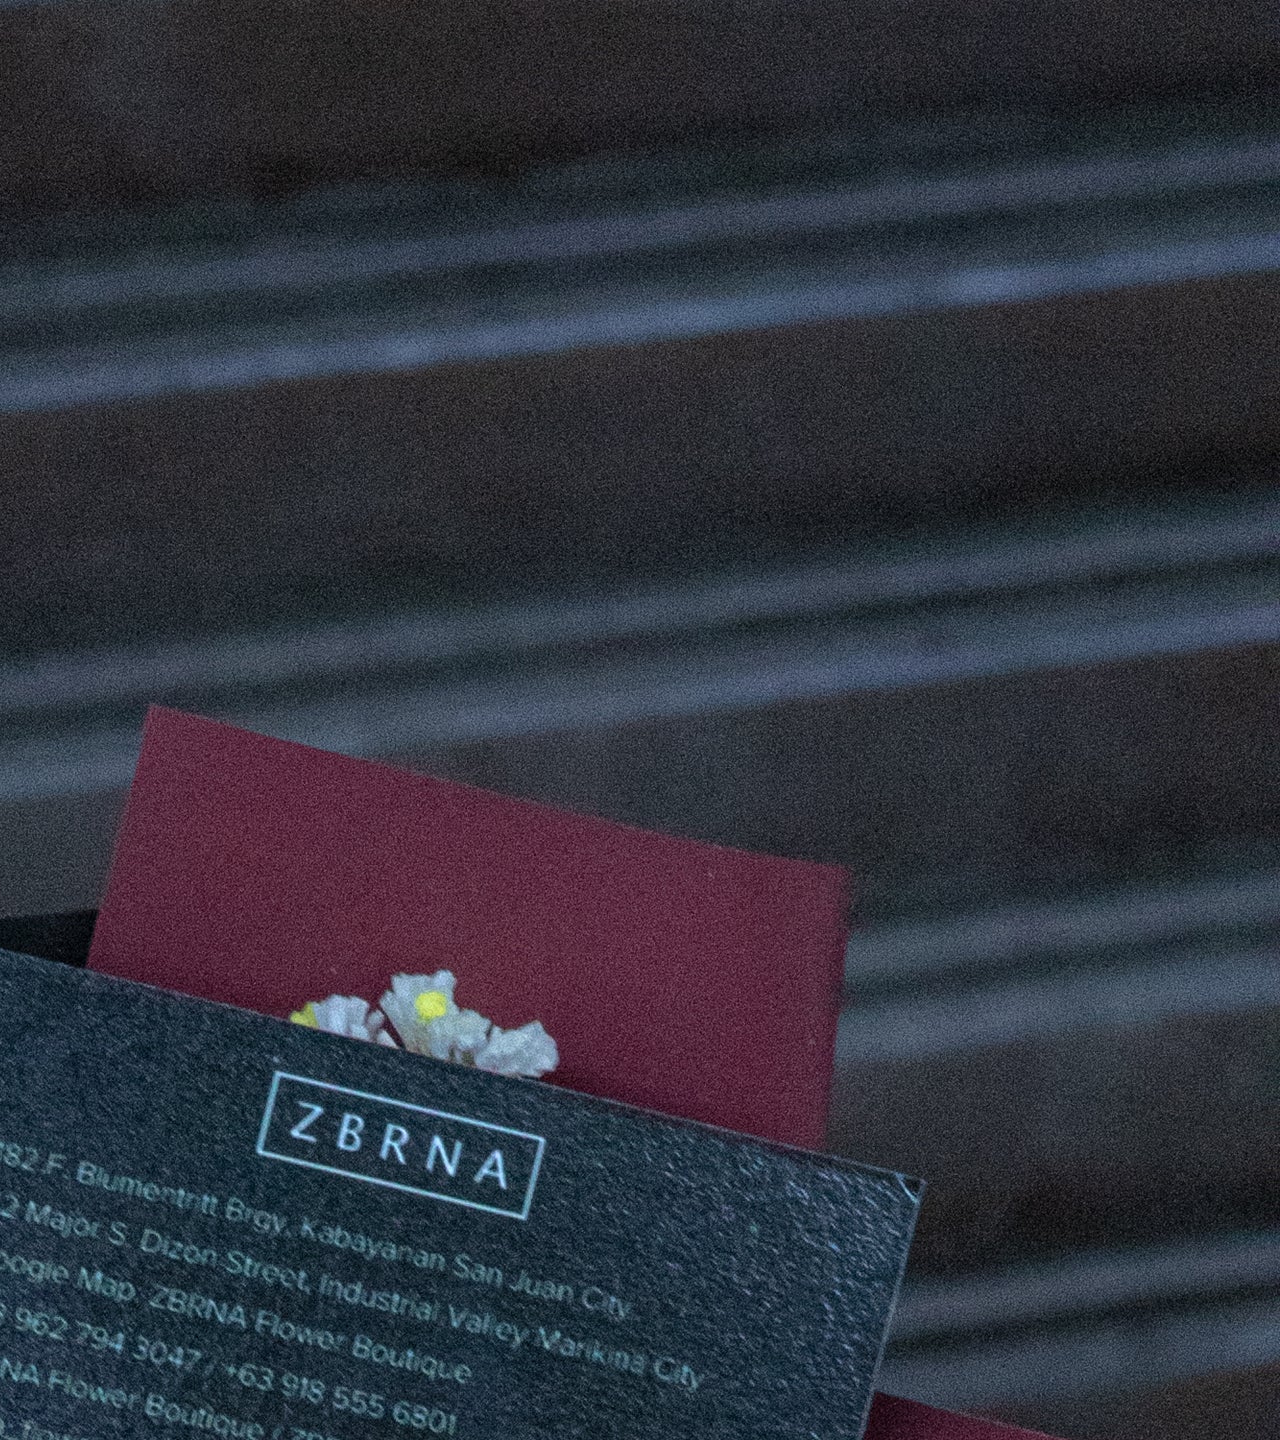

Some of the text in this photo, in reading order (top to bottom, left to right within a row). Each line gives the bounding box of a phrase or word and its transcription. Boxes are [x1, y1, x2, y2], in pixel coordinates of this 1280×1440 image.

[288, 1098, 516, 1193] ZBRNA
[22, 1198, 101, 1246] Major
[138, 1227, 220, 1270] Dizon
[317, 1272, 440, 1325] Industrial
[442, 1303, 530, 1351] Valley
[533, 1325, 648, 1376] Marikina
[649, 1354, 706, 1395] City
[74, 1160, 222, 1218] Blumentritt
[296, 1216, 447, 1278] Kabayanan
[450, 1252, 506, 1288] San
[508, 1267, 576, 1306] Juan
[579, 1284, 633, 1323] City
[11, 1305, 70, 1342] 962
[70, 1320, 126, 1356] 794
[131, 1334, 203, 1375] 3047
[223, 1358, 276, 1393] +63
[277, 1370, 327, 1406] 918
[330, 1384, 387, 1420] 555
[390, 1399, 459, 1438] 6801
[46, 1369, 139, 1413] Flower
[147, 1282, 250, 1331] ZBRNA
[253, 1308, 349, 1355] Flower
[349, 1333, 475, 1391] Boutique
